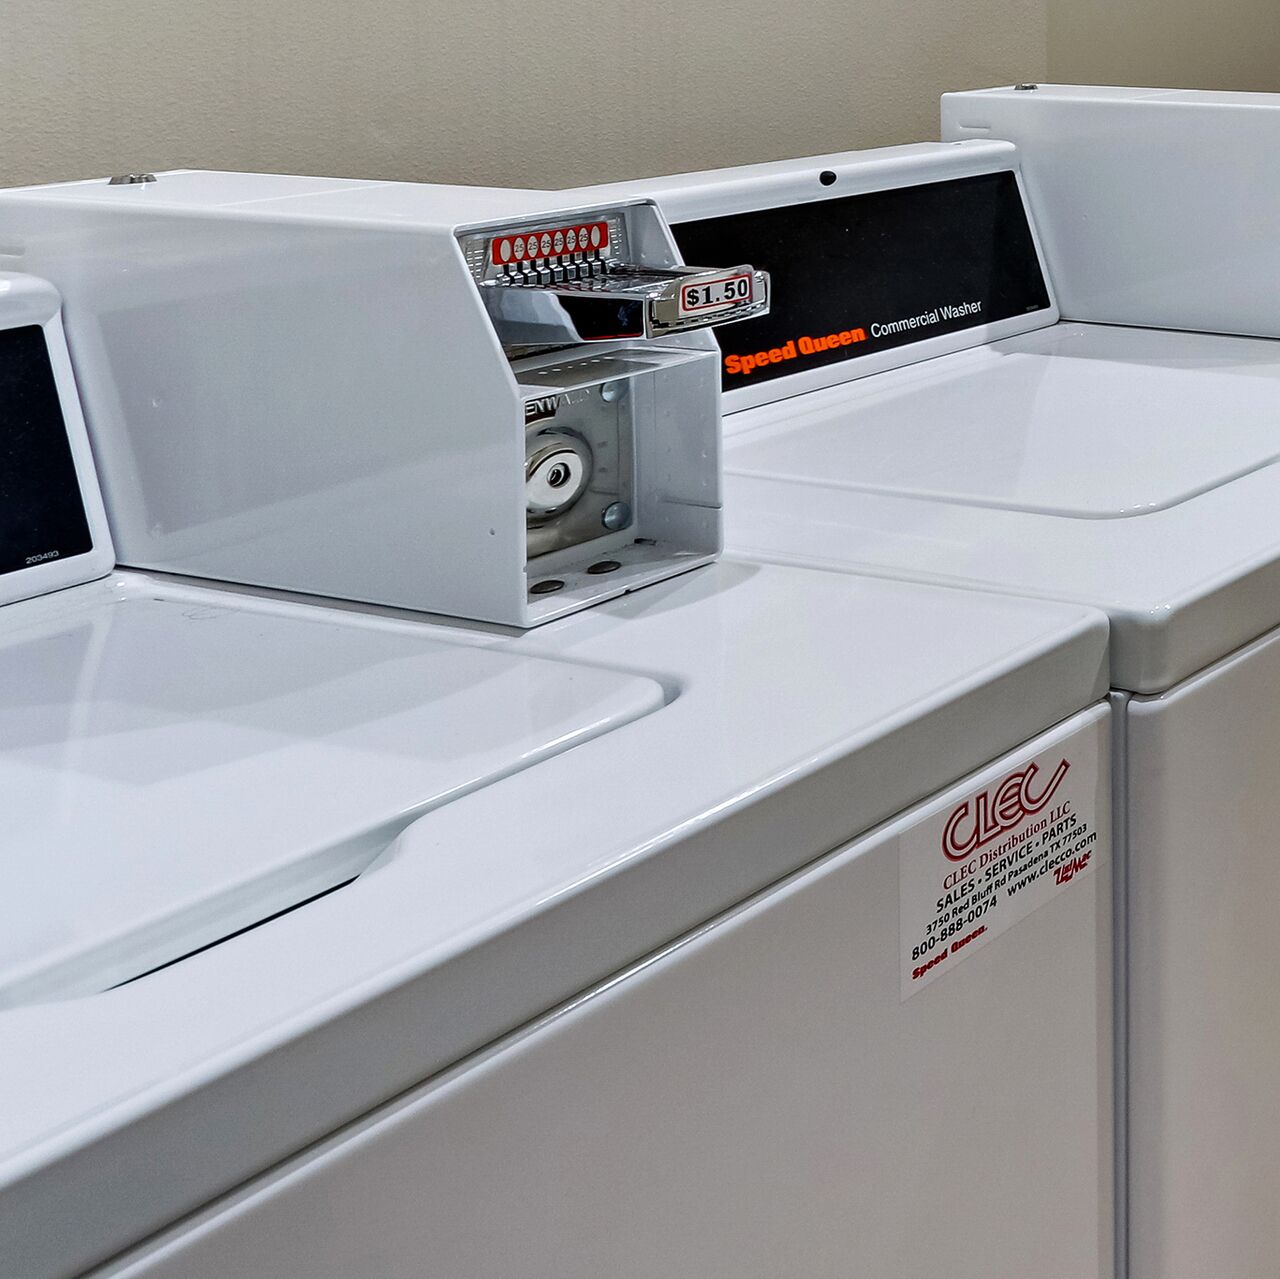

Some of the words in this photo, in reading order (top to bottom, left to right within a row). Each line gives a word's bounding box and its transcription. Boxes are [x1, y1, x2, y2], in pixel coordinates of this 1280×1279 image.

[515, 244, 524, 253] 25
[528, 241, 538, 250] 25
[541, 240, 551, 249] 25
[554, 238, 563, 247] 25
[567, 236, 576, 244] 25
[580, 234, 589, 243] 25
[686, 279, 748, 306] $1.50
[725, 340, 796, 375] Speed
[798, 327, 867, 356] Queen
[870, 309, 939, 338] Commercial
[940, 300, 982, 322] Washer
[25, 550, 59, 564] 203493
[942, 758, 1071, 862] CLEC
[943, 859, 977, 890] CLEC
[979, 818, 1048, 867] Distribution
[1049, 801, 1071, 824] LLC
[936, 878, 975, 914] SALES
[985, 841, 1033, 883] SERVICE
[1042, 813, 1077, 846] PARTS
[926, 914, 950, 936] 3750
[951, 897, 970, 918] Red
[971, 882, 993, 907] Bluff
[994, 874, 1007, 890] Rd
[1007, 850, 1049, 882] Pasadena
[1049, 839, 1061, 854] TX
[1062, 823, 1088, 846] 77503
[911, 894, 998, 961] 800-888-0074
[1007, 831, 1098, 898] www.clecco.com
[911, 948, 948, 980] Speed
